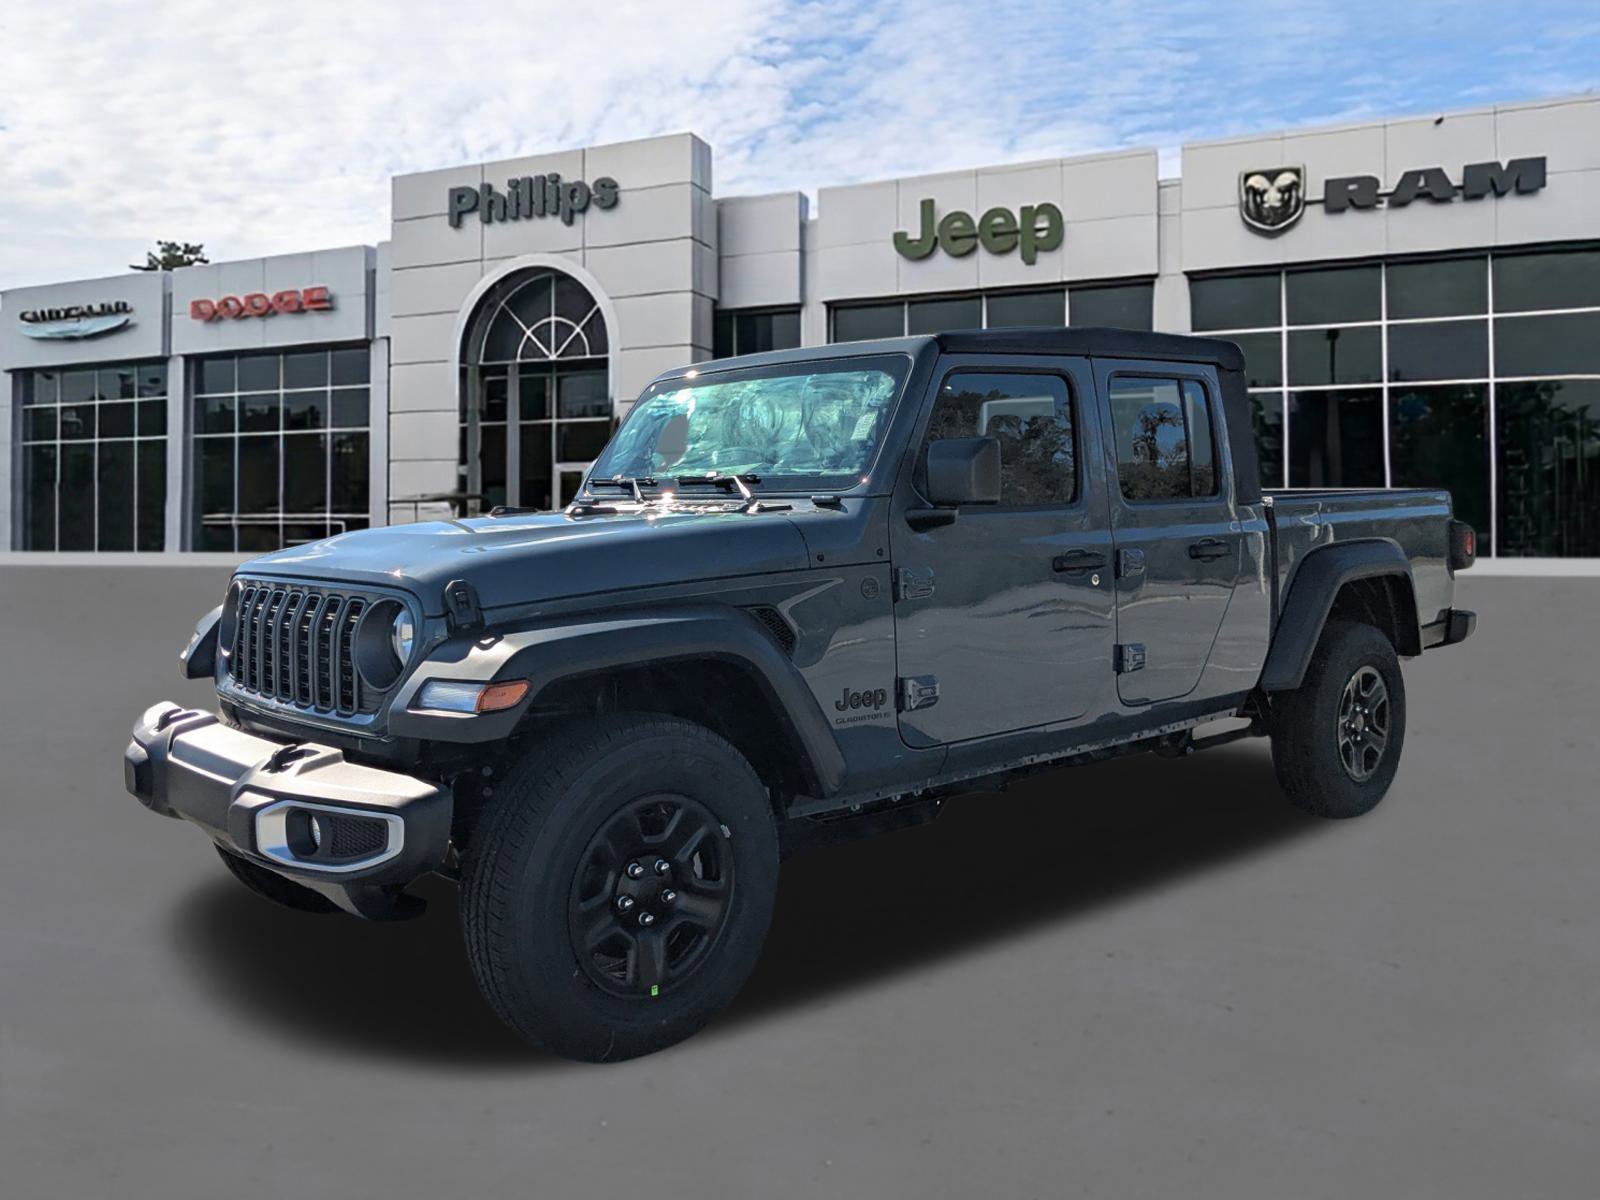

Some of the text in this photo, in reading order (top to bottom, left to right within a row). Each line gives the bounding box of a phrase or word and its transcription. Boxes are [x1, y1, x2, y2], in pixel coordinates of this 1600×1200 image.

[448, 172, 619, 228] Phillips
[1324, 156, 1547, 214] RAM
[893, 198, 1065, 266] Jeep
[190, 286, 333, 322] DODGE
[835, 687, 888, 712] Jeep
